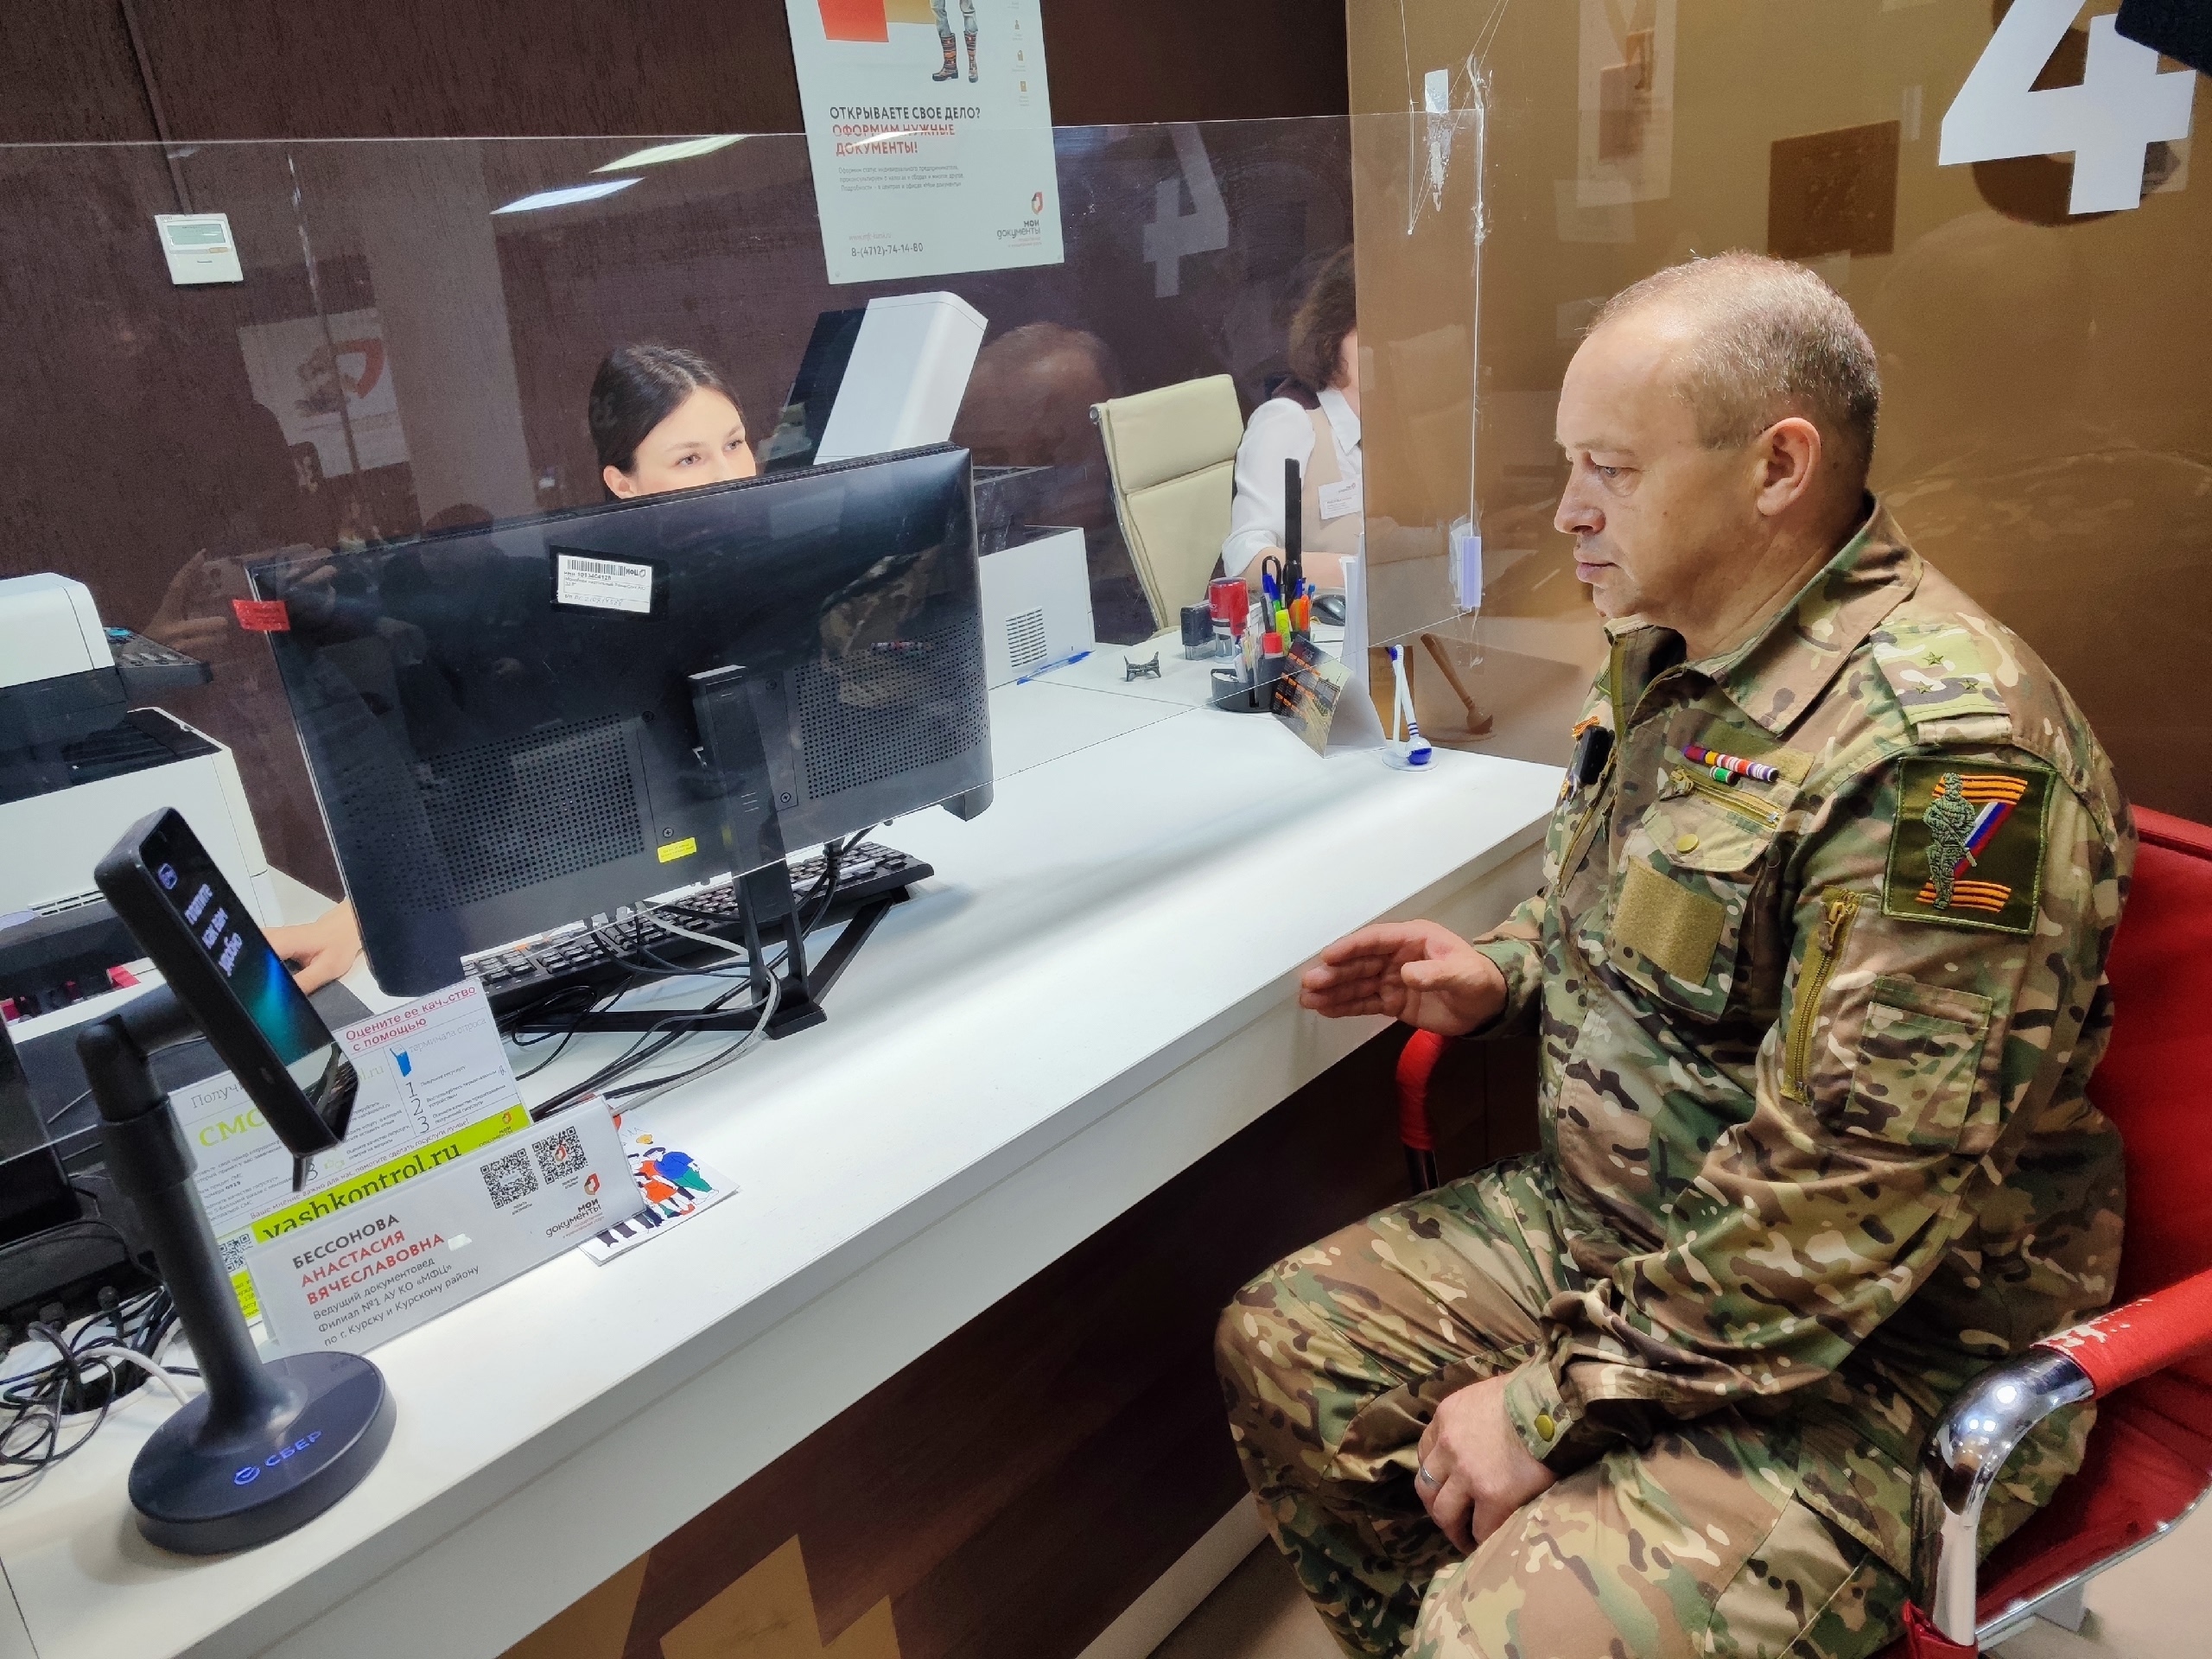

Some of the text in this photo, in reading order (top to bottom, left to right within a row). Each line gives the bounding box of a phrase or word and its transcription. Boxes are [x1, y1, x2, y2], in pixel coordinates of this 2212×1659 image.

[830, 106, 981, 121] ОТКРЫВАЕТЕ СВОЕ ДЕЛО?
[1938, 0, 2196, 215] 4
[832, 124, 955, 137] ОФОРМИМ НУЖНЫЕ
[836, 141, 919, 157] ДОКУМЕНТЫ!
[996, 226, 1041, 239] документы
[851, 243, 924, 258] 8-(4712)-74-14-80
[346, 1014, 401, 1040] Оцените
[404, 1007, 418, 1019] ее
[353, 1017, 427, 1052] с помощью
[408, 1017, 486, 1053] терминала опроса
[405, 1081, 418, 1099] 1
[410, 1098, 423, 1116] 2
[199, 1108, 265, 1147] СМС
[417, 1116, 430, 1134] 3
[251, 1206, 270, 1220] Ваше
[272, 1193, 301, 1211] мнение
[302, 1183, 326, 1197] важно
[327, 1175, 340, 1187] для
[355, 1155, 387, 1174] помогите
[389, 1144, 414, 1160] сделать
[262, 1142, 462, 1238] vashkontrol.ru
[546, 1204, 601, 1237] документы
[577, 1198, 599, 1212] мои
[292, 1214, 400, 1269] БЕССОНОВА
[302, 1230, 405, 1288] АНАСТАСИЯ
[306, 1233, 445, 1306] ВЯЧЕСЛАВОВНА
[313, 1257, 435, 1320] Ведущий документовед
[318, 1264, 453, 1333] Филиал №1 АУ КО «МФЦ»
[324, 1264, 480, 1347] по г. Курску и Курскому району
[265, 1431, 322, 1466] СБЕР
